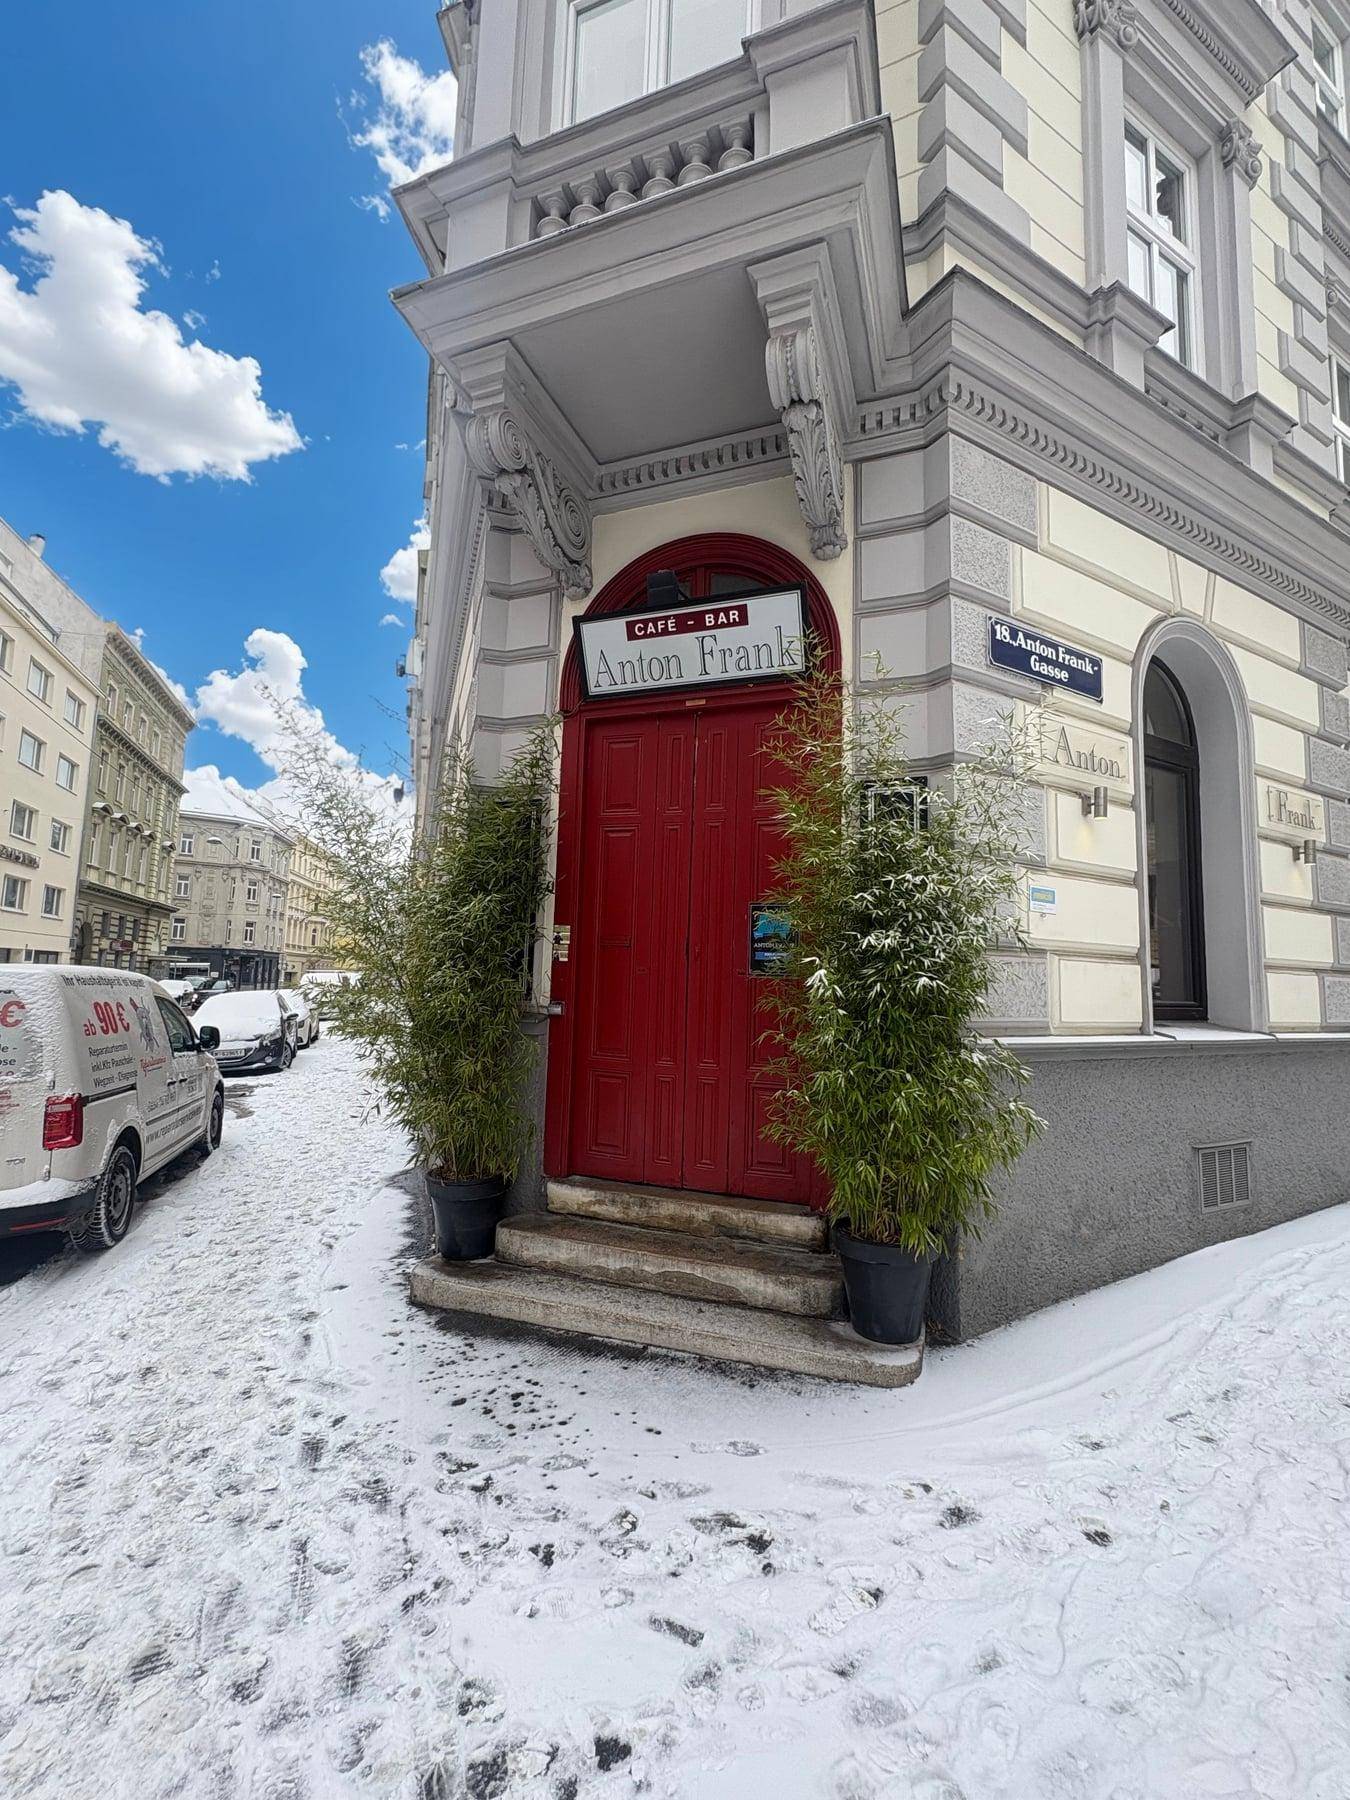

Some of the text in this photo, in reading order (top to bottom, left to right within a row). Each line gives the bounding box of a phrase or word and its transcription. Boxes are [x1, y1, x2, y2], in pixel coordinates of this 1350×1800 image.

[634, 616, 677, 637] CAFÉ
[705, 609, 740, 627] BAR
[593, 625, 799, 689] Anton Frank
[1030, 655, 1070, 682] Gasse
[1054, 725, 1121, 779] Anton
[1275, 789, 1317, 830] Frank
[83, 1018, 97, 1037] ab
